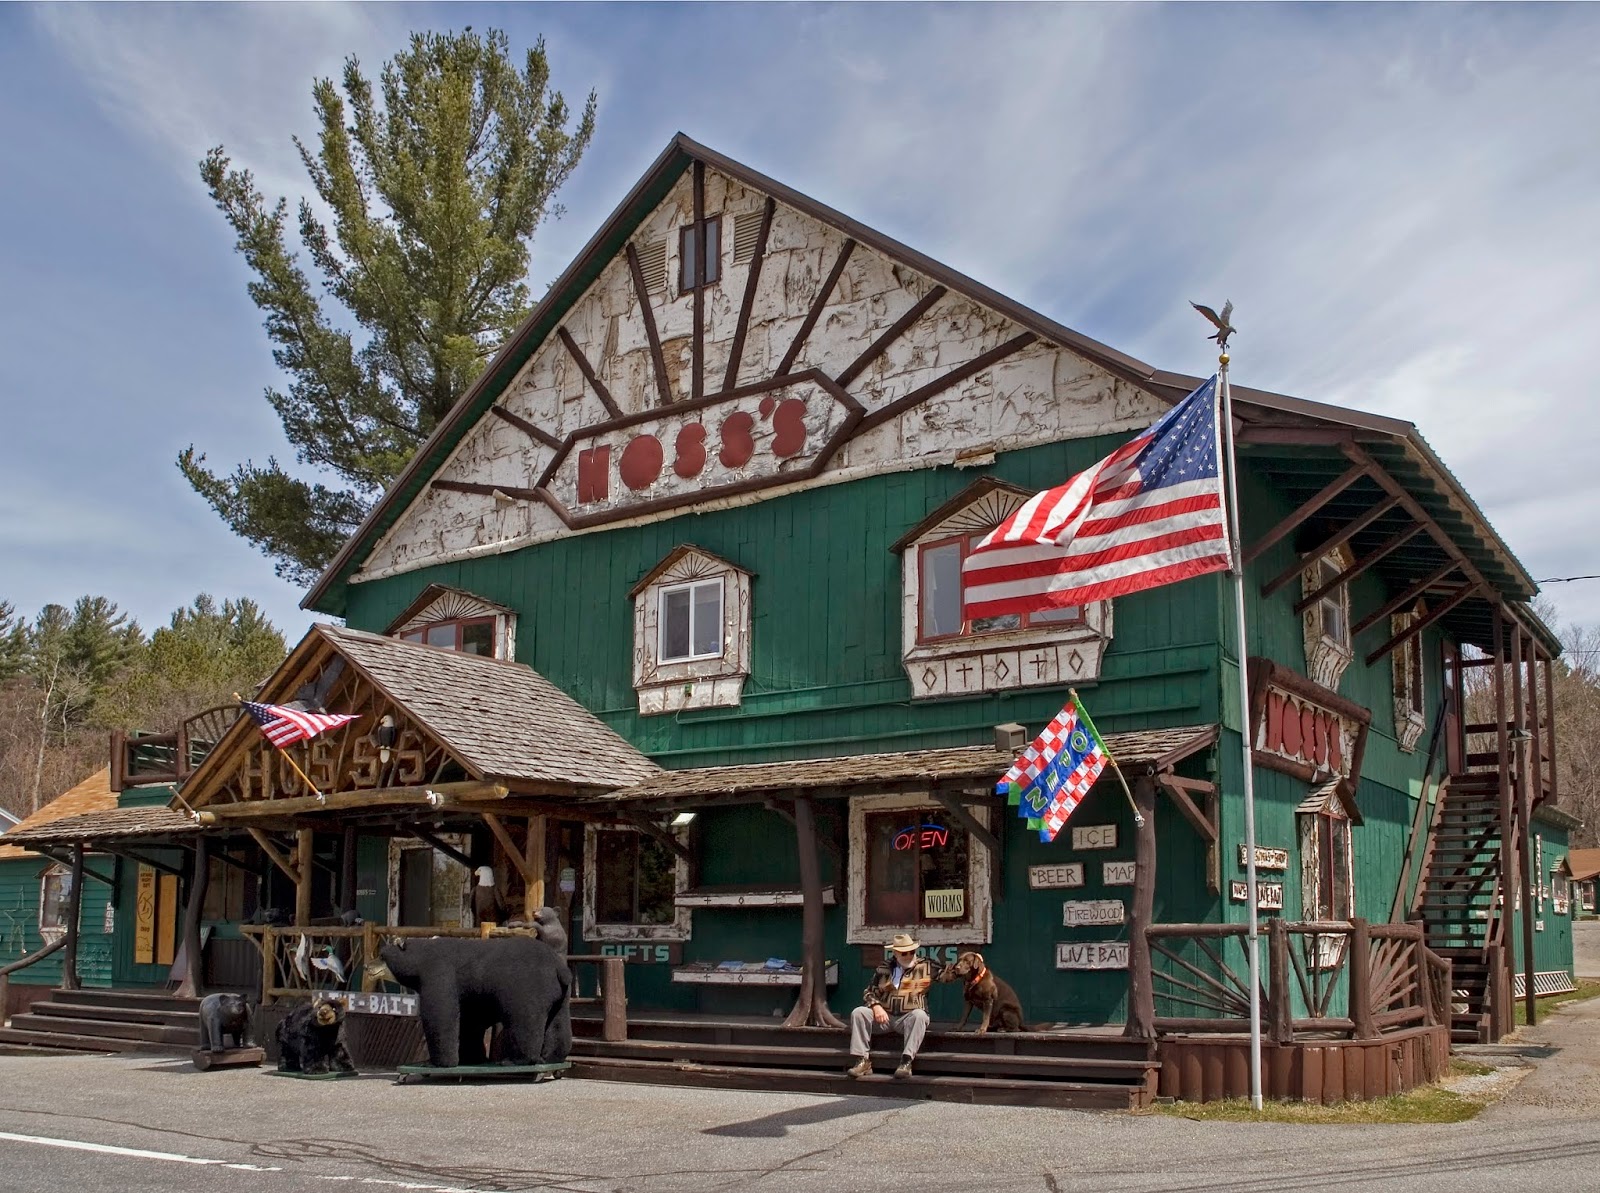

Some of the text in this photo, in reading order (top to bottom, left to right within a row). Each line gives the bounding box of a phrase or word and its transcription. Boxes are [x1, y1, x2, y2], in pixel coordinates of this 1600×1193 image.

[577, 396, 807, 504] HOSS'S
[1024, 730, 1088, 813] OPEN
[894, 830, 949, 851] OPEN
[1079, 828, 1114, 846] ICE
[1036, 868, 1077, 885] BEER
[926, 894, 963, 914] WORMS
[1066, 906, 1121, 921] FIREWOOD
[601, 944, 670, 962] GIFTS
[884, 945, 959, 965] OKS
[317, 992, 416, 1015] E-BAIT
